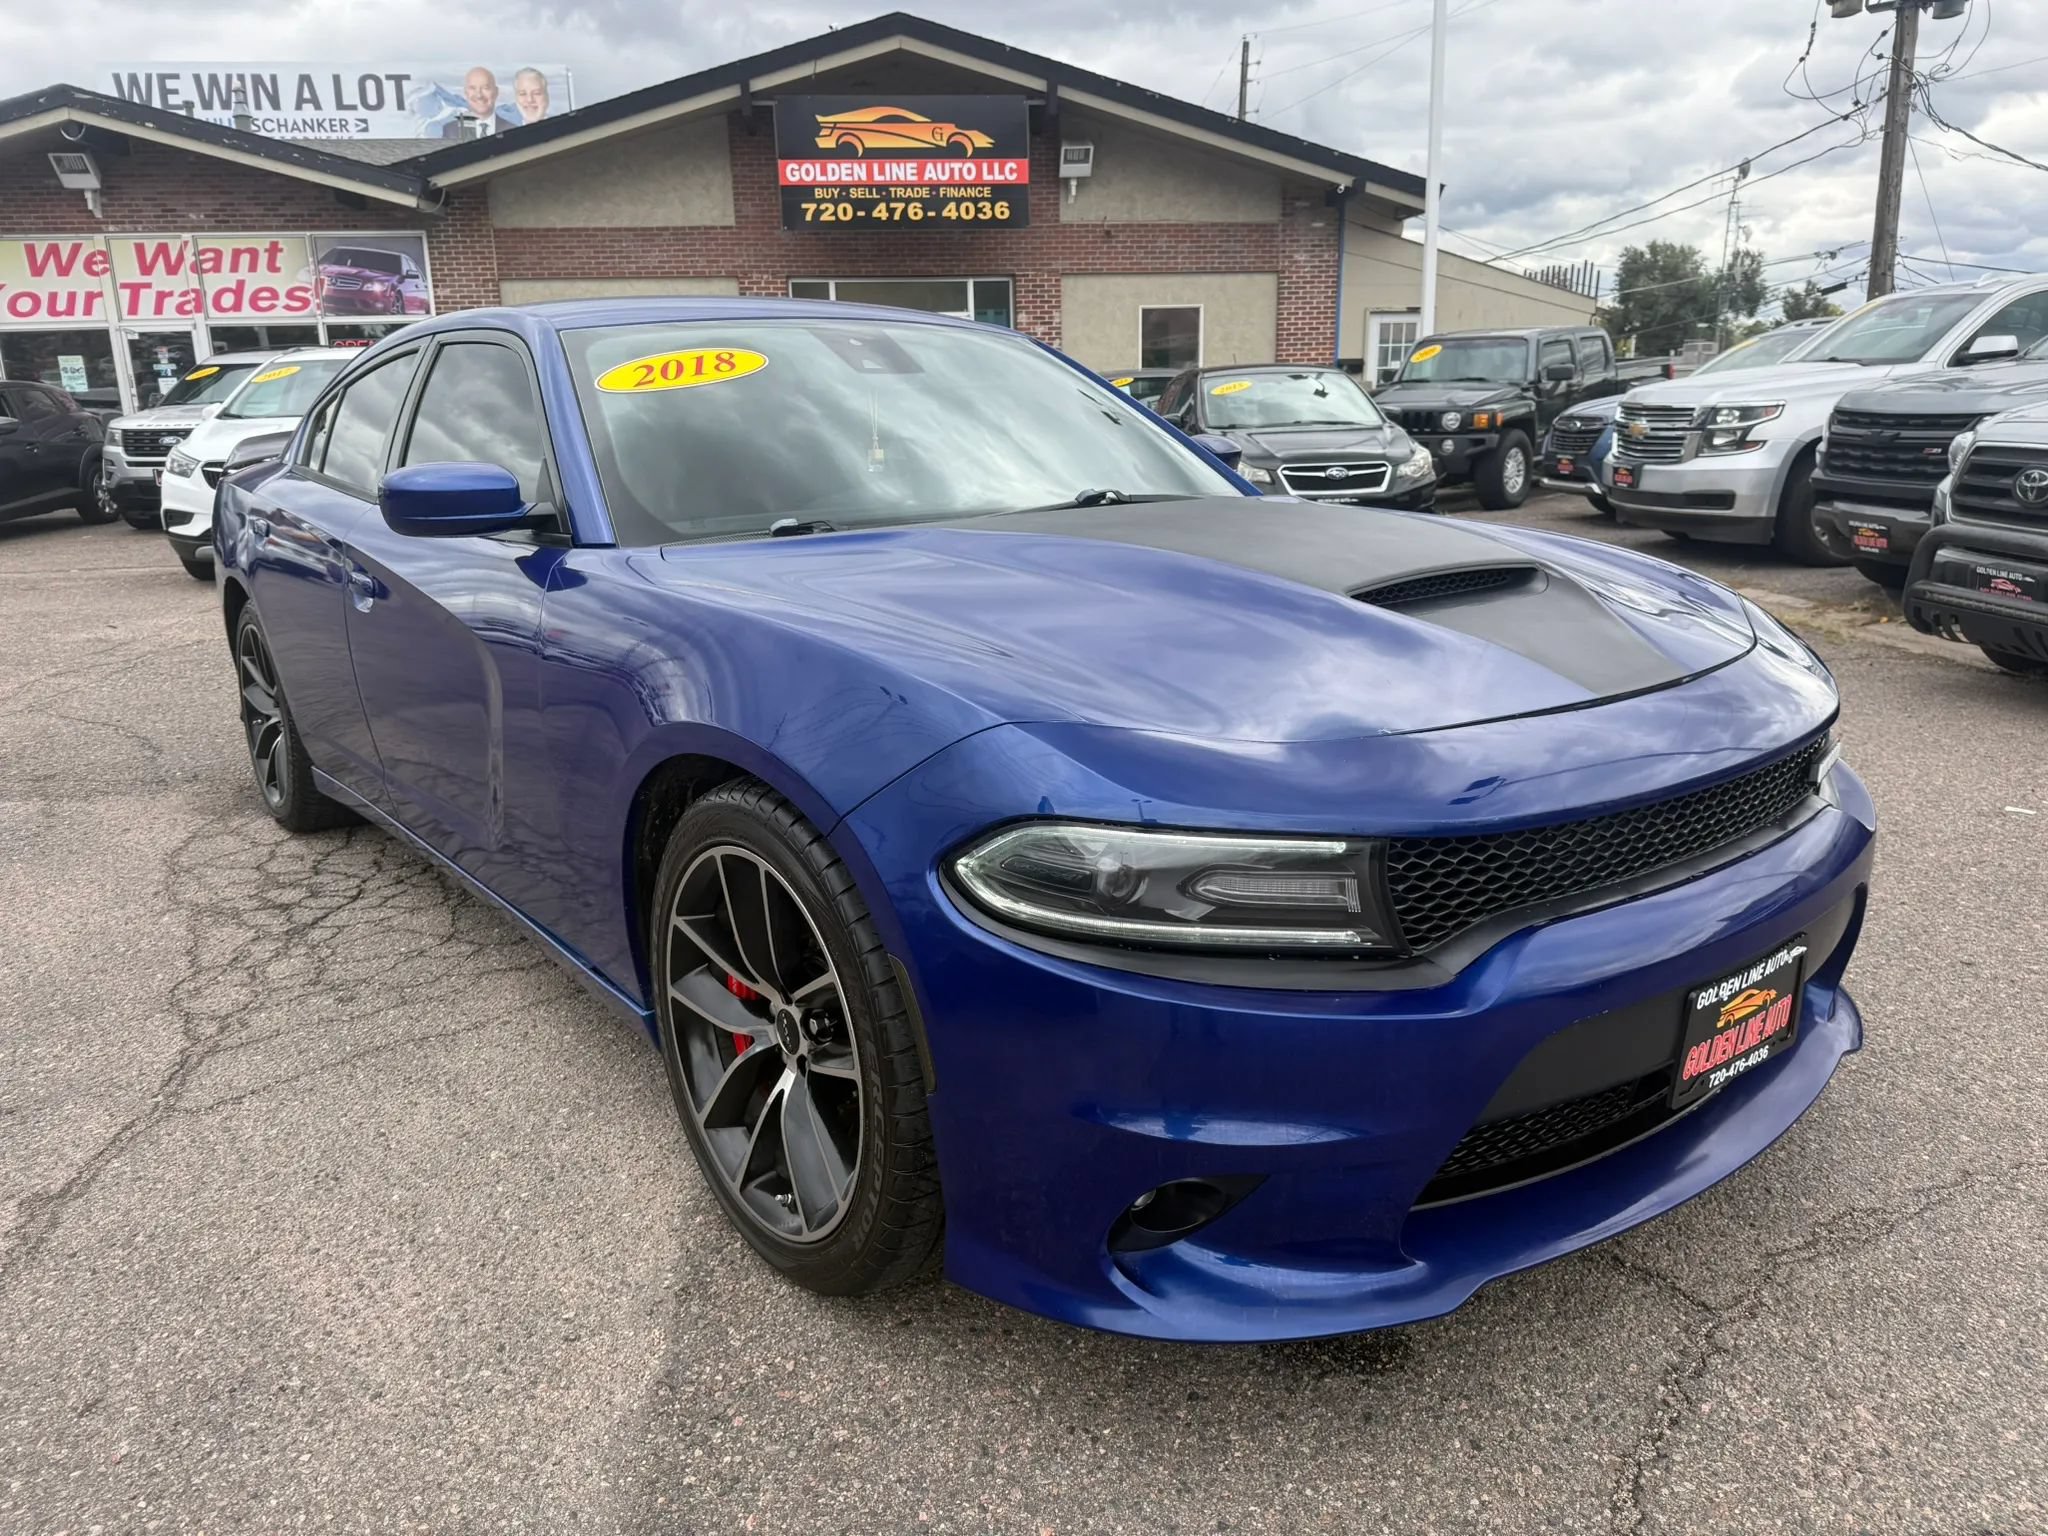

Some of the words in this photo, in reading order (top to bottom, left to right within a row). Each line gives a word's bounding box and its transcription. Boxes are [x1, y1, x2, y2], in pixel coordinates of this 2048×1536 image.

[111, 72, 184, 111] WE
[294, 73, 323, 111] A
[332, 73, 411, 111] LOT
[251, 118, 350, 133] SCHANKER
[786, 163, 866, 182] GOLDEN
[873, 163, 917, 181] LINE
[924, 162, 976, 181] AUTO
[982, 162, 1018, 180] LLC
[815, 188, 840, 199] BUY
[849, 188, 880, 198] SELL
[889, 187, 930, 198] TRADE
[940, 187, 991, 197] FINANCE
[23, 242, 110, 277] We
[133, 240, 284, 276] Want
[0, 283, 104, 318] our
[633, 351, 736, 388] 2018
[1697, 975, 1742, 1010] GOLDEN
[1741, 963, 1766, 989] LINE
[1764, 950, 1788, 977] AUTO
[1683, 1025, 1739, 1080] GOLDEN
[1735, 1011, 1766, 1055] LINE
[1764, 994, 1793, 1039] AUTO
[1709, 1045, 1769, 1088] 720-476-4036
